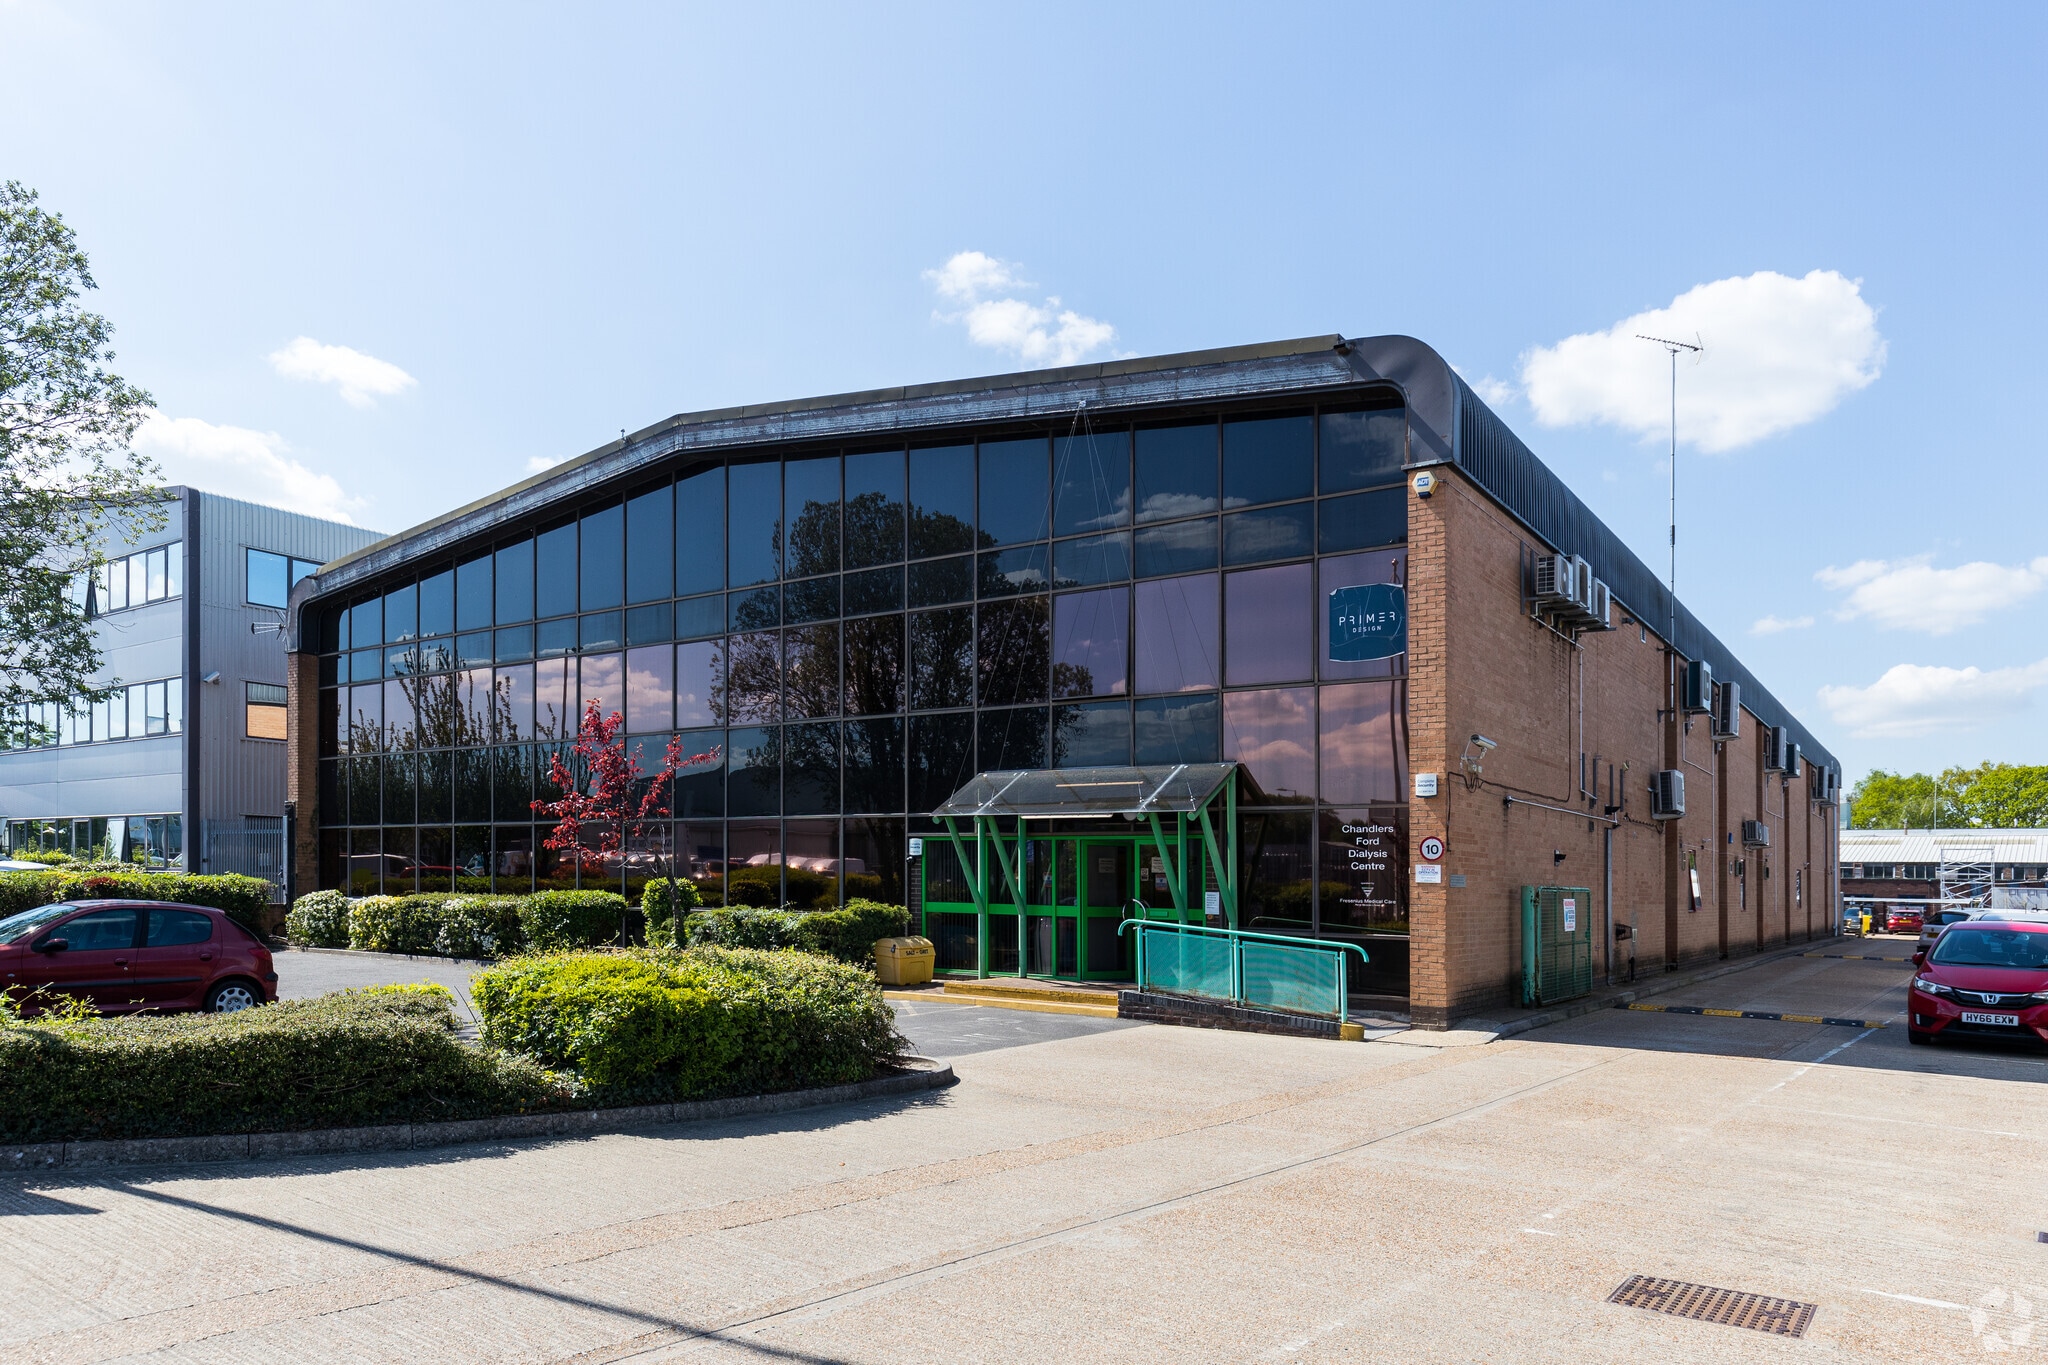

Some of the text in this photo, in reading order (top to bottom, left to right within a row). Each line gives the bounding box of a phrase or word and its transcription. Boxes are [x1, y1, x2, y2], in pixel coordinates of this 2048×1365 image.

[1338, 612, 1396, 626] PRIMER
[1342, 825, 1394, 833] Chandlers
[1356, 837, 1380, 845] Ford
[1425, 844, 1439, 855] 10
[1348, 850, 1388, 860] Dialysis
[1351, 862, 1385, 870] Centre
[1966, 1014, 2014, 1024] HY66 EXW
